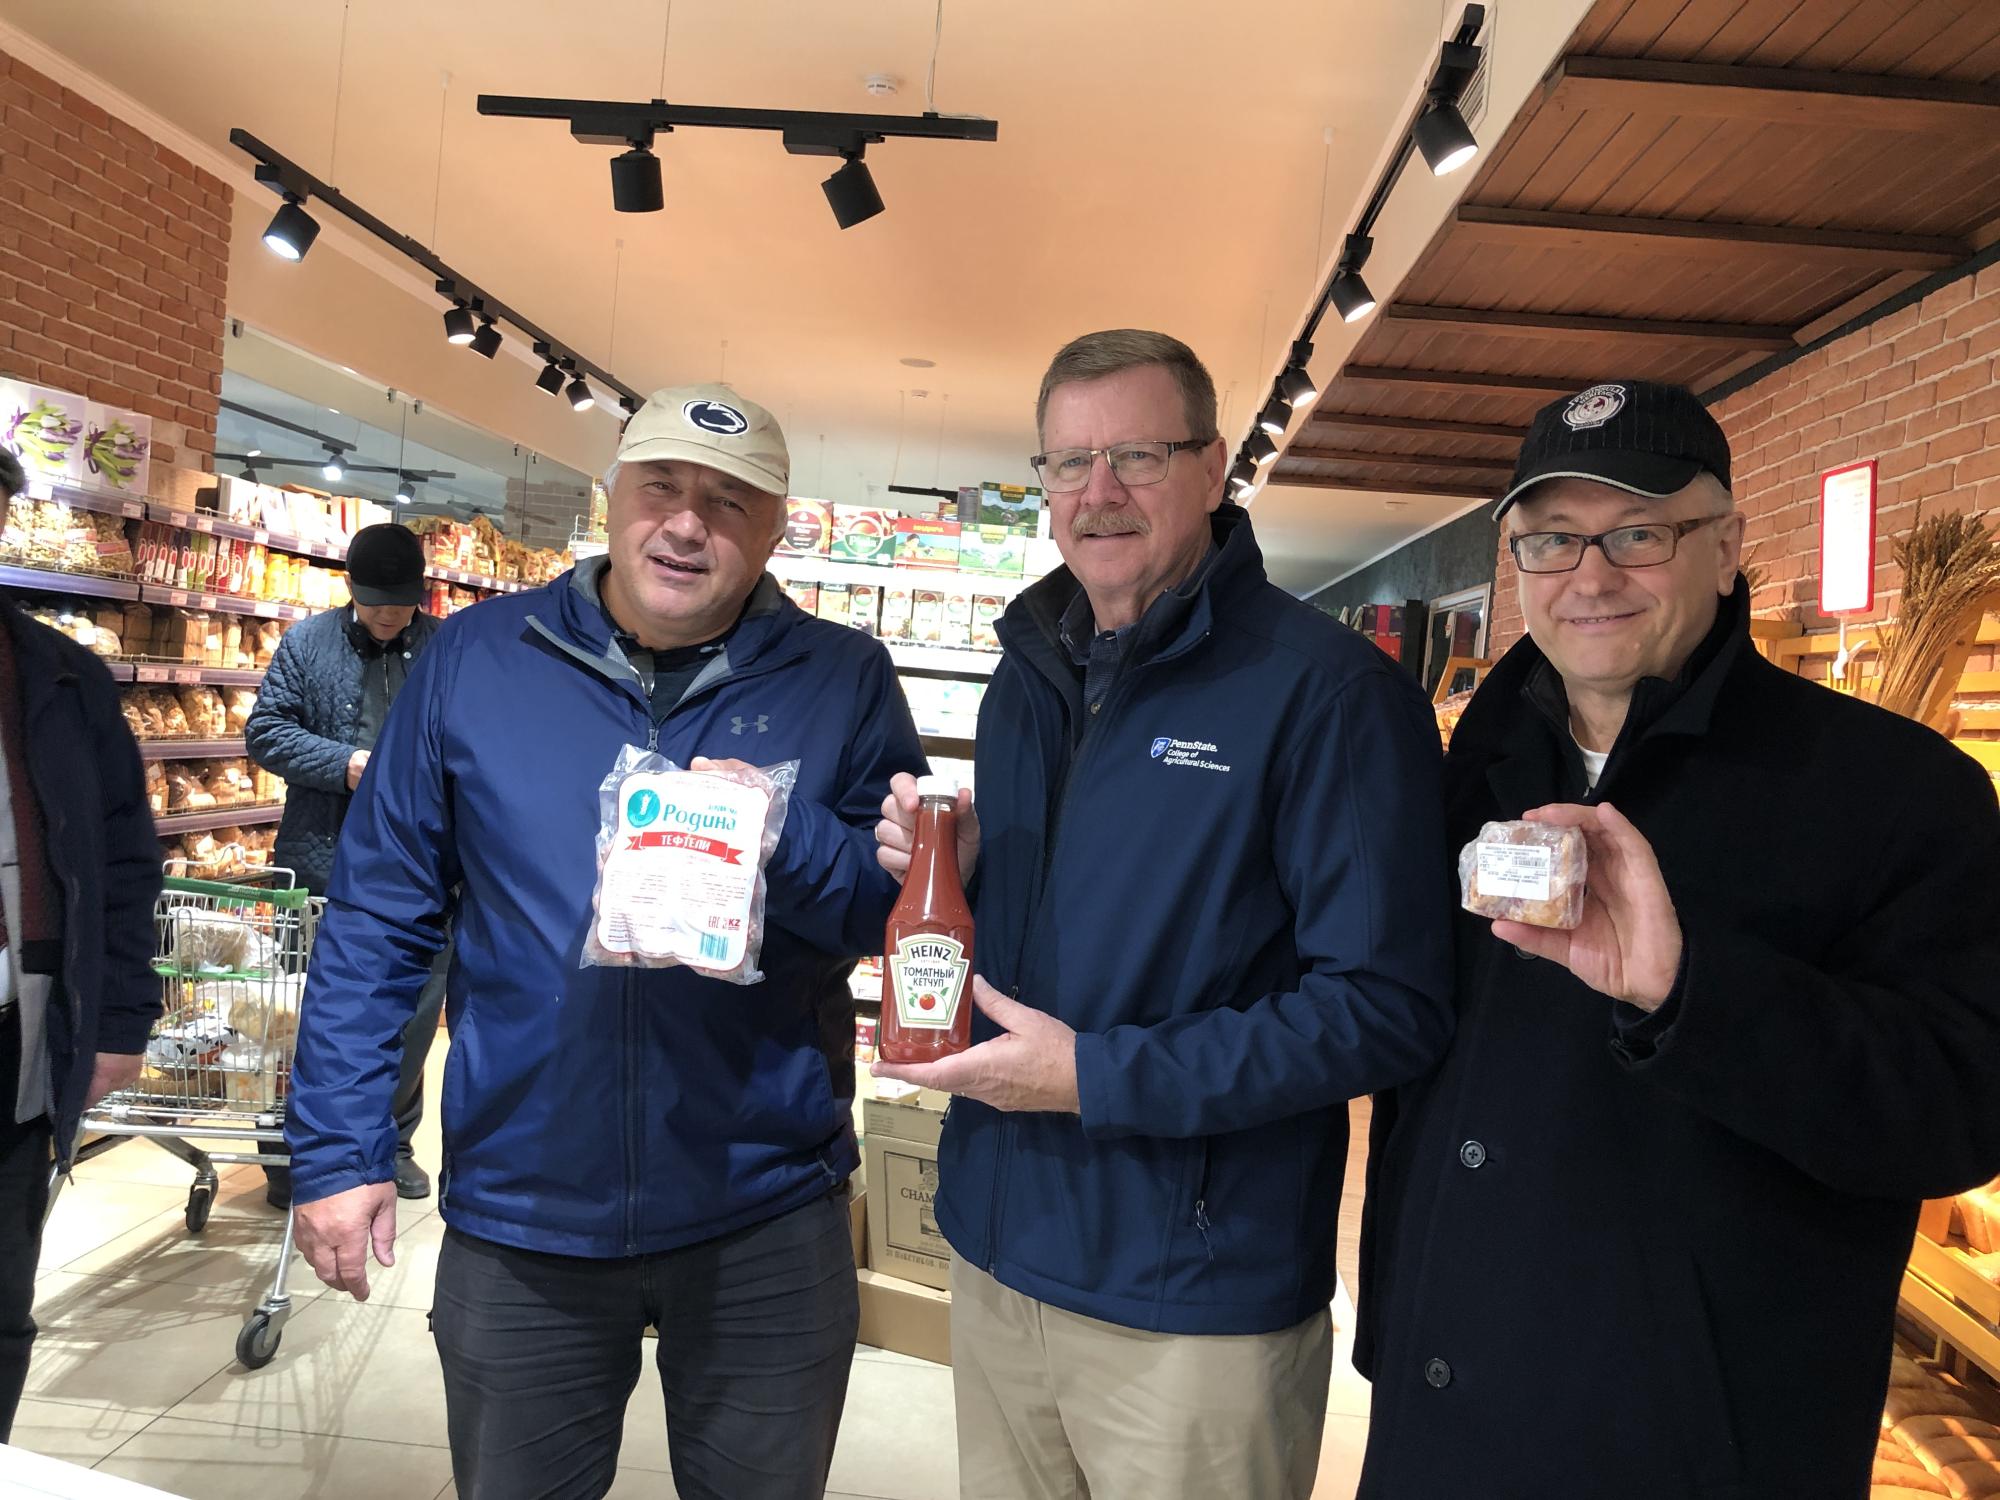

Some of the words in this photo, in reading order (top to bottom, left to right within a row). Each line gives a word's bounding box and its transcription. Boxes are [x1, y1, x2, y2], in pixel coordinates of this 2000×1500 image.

[1170, 739, 1216, 752] PennState
[1167, 749, 1190, 758] College
[1163, 756, 1200, 766] Agricultural
[1200, 760, 1231, 772] Sciences
[663, 804, 736, 832] Родина
[661, 834, 711, 851] ТЕФТЕЛИ
[728, 918, 741, 927] KZ
[910, 945, 951, 961] HEINZ
[903, 966, 955, 979] ТОМАТНЫЙ
[913, 977, 945, 987] КЕТЧУП
